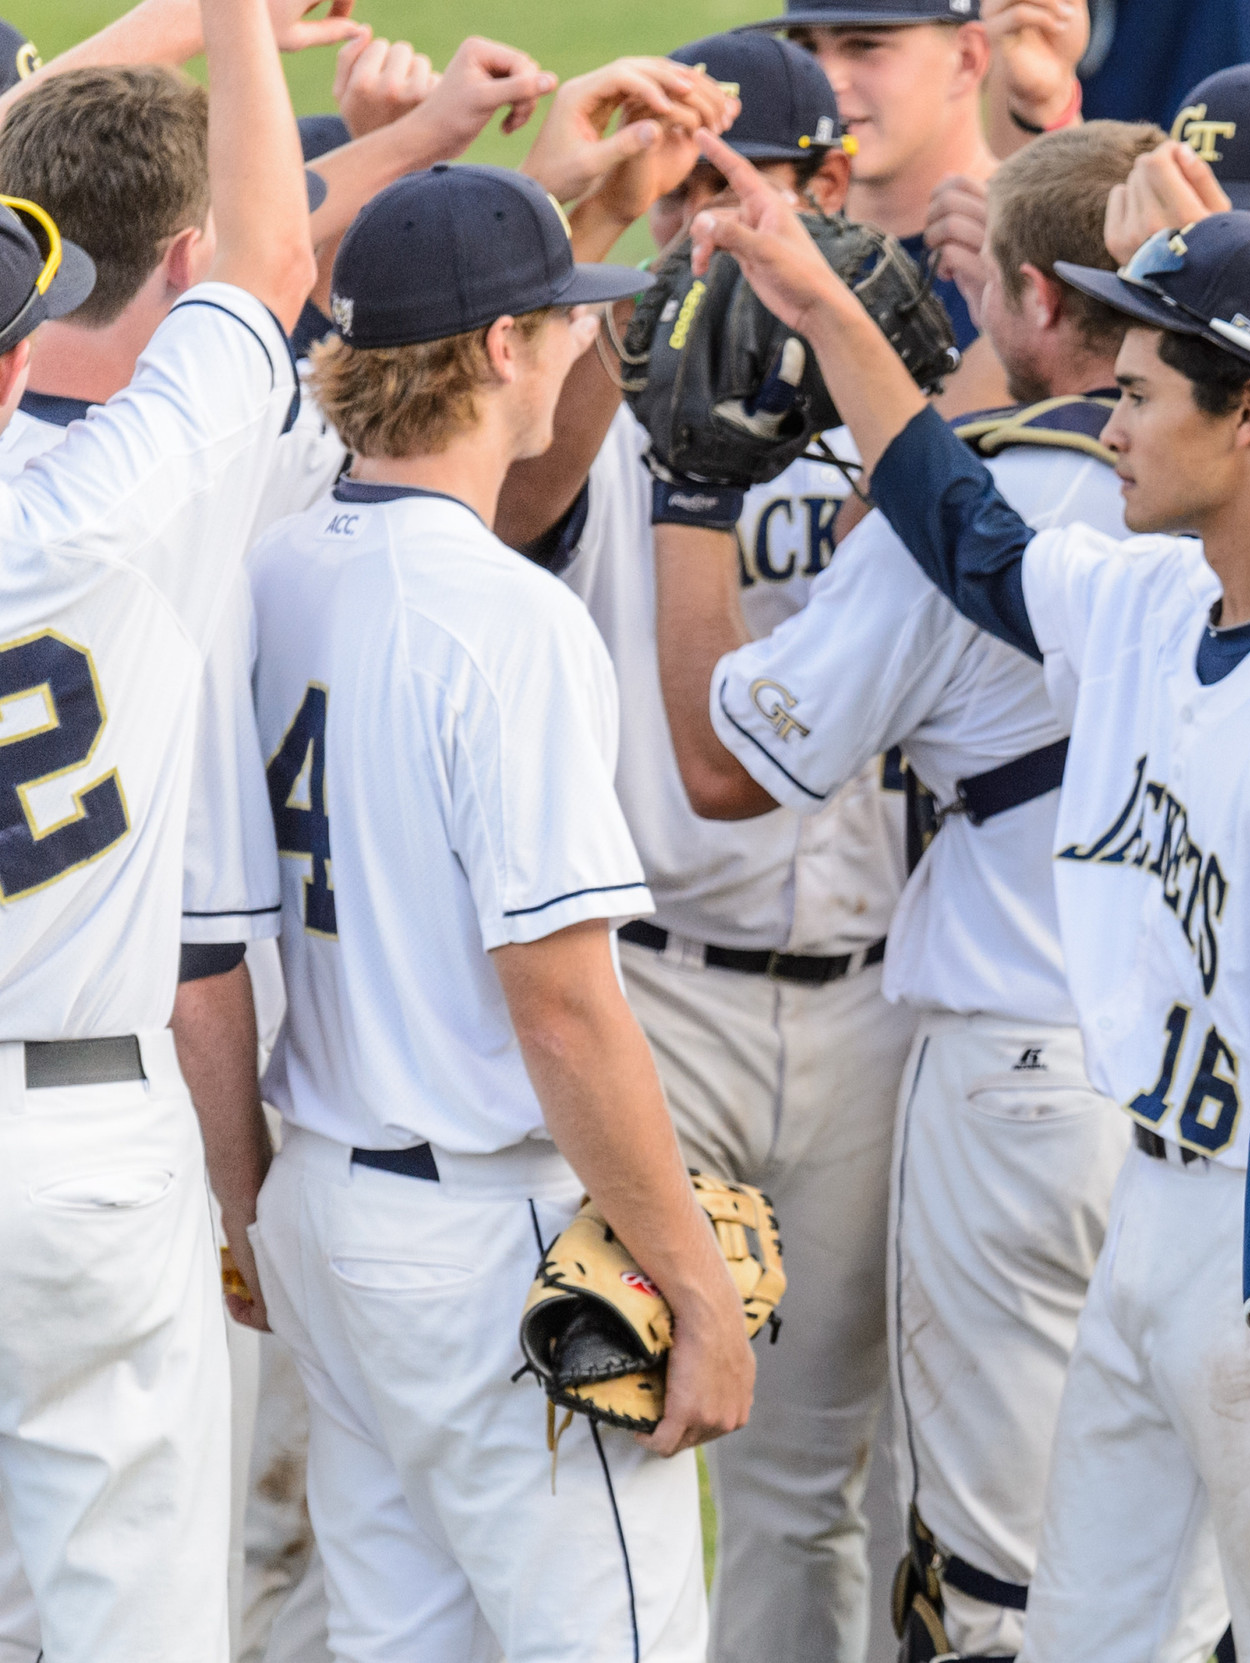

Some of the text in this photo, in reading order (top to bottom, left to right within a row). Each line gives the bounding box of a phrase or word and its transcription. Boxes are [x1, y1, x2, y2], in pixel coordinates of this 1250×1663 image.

[16, 40, 43, 80] G
[323, 514, 360, 536] ACC
[748, 678, 811, 742] GT
[265, 679, 340, 942] 4
[1123, 1001, 1243, 1158] 16
